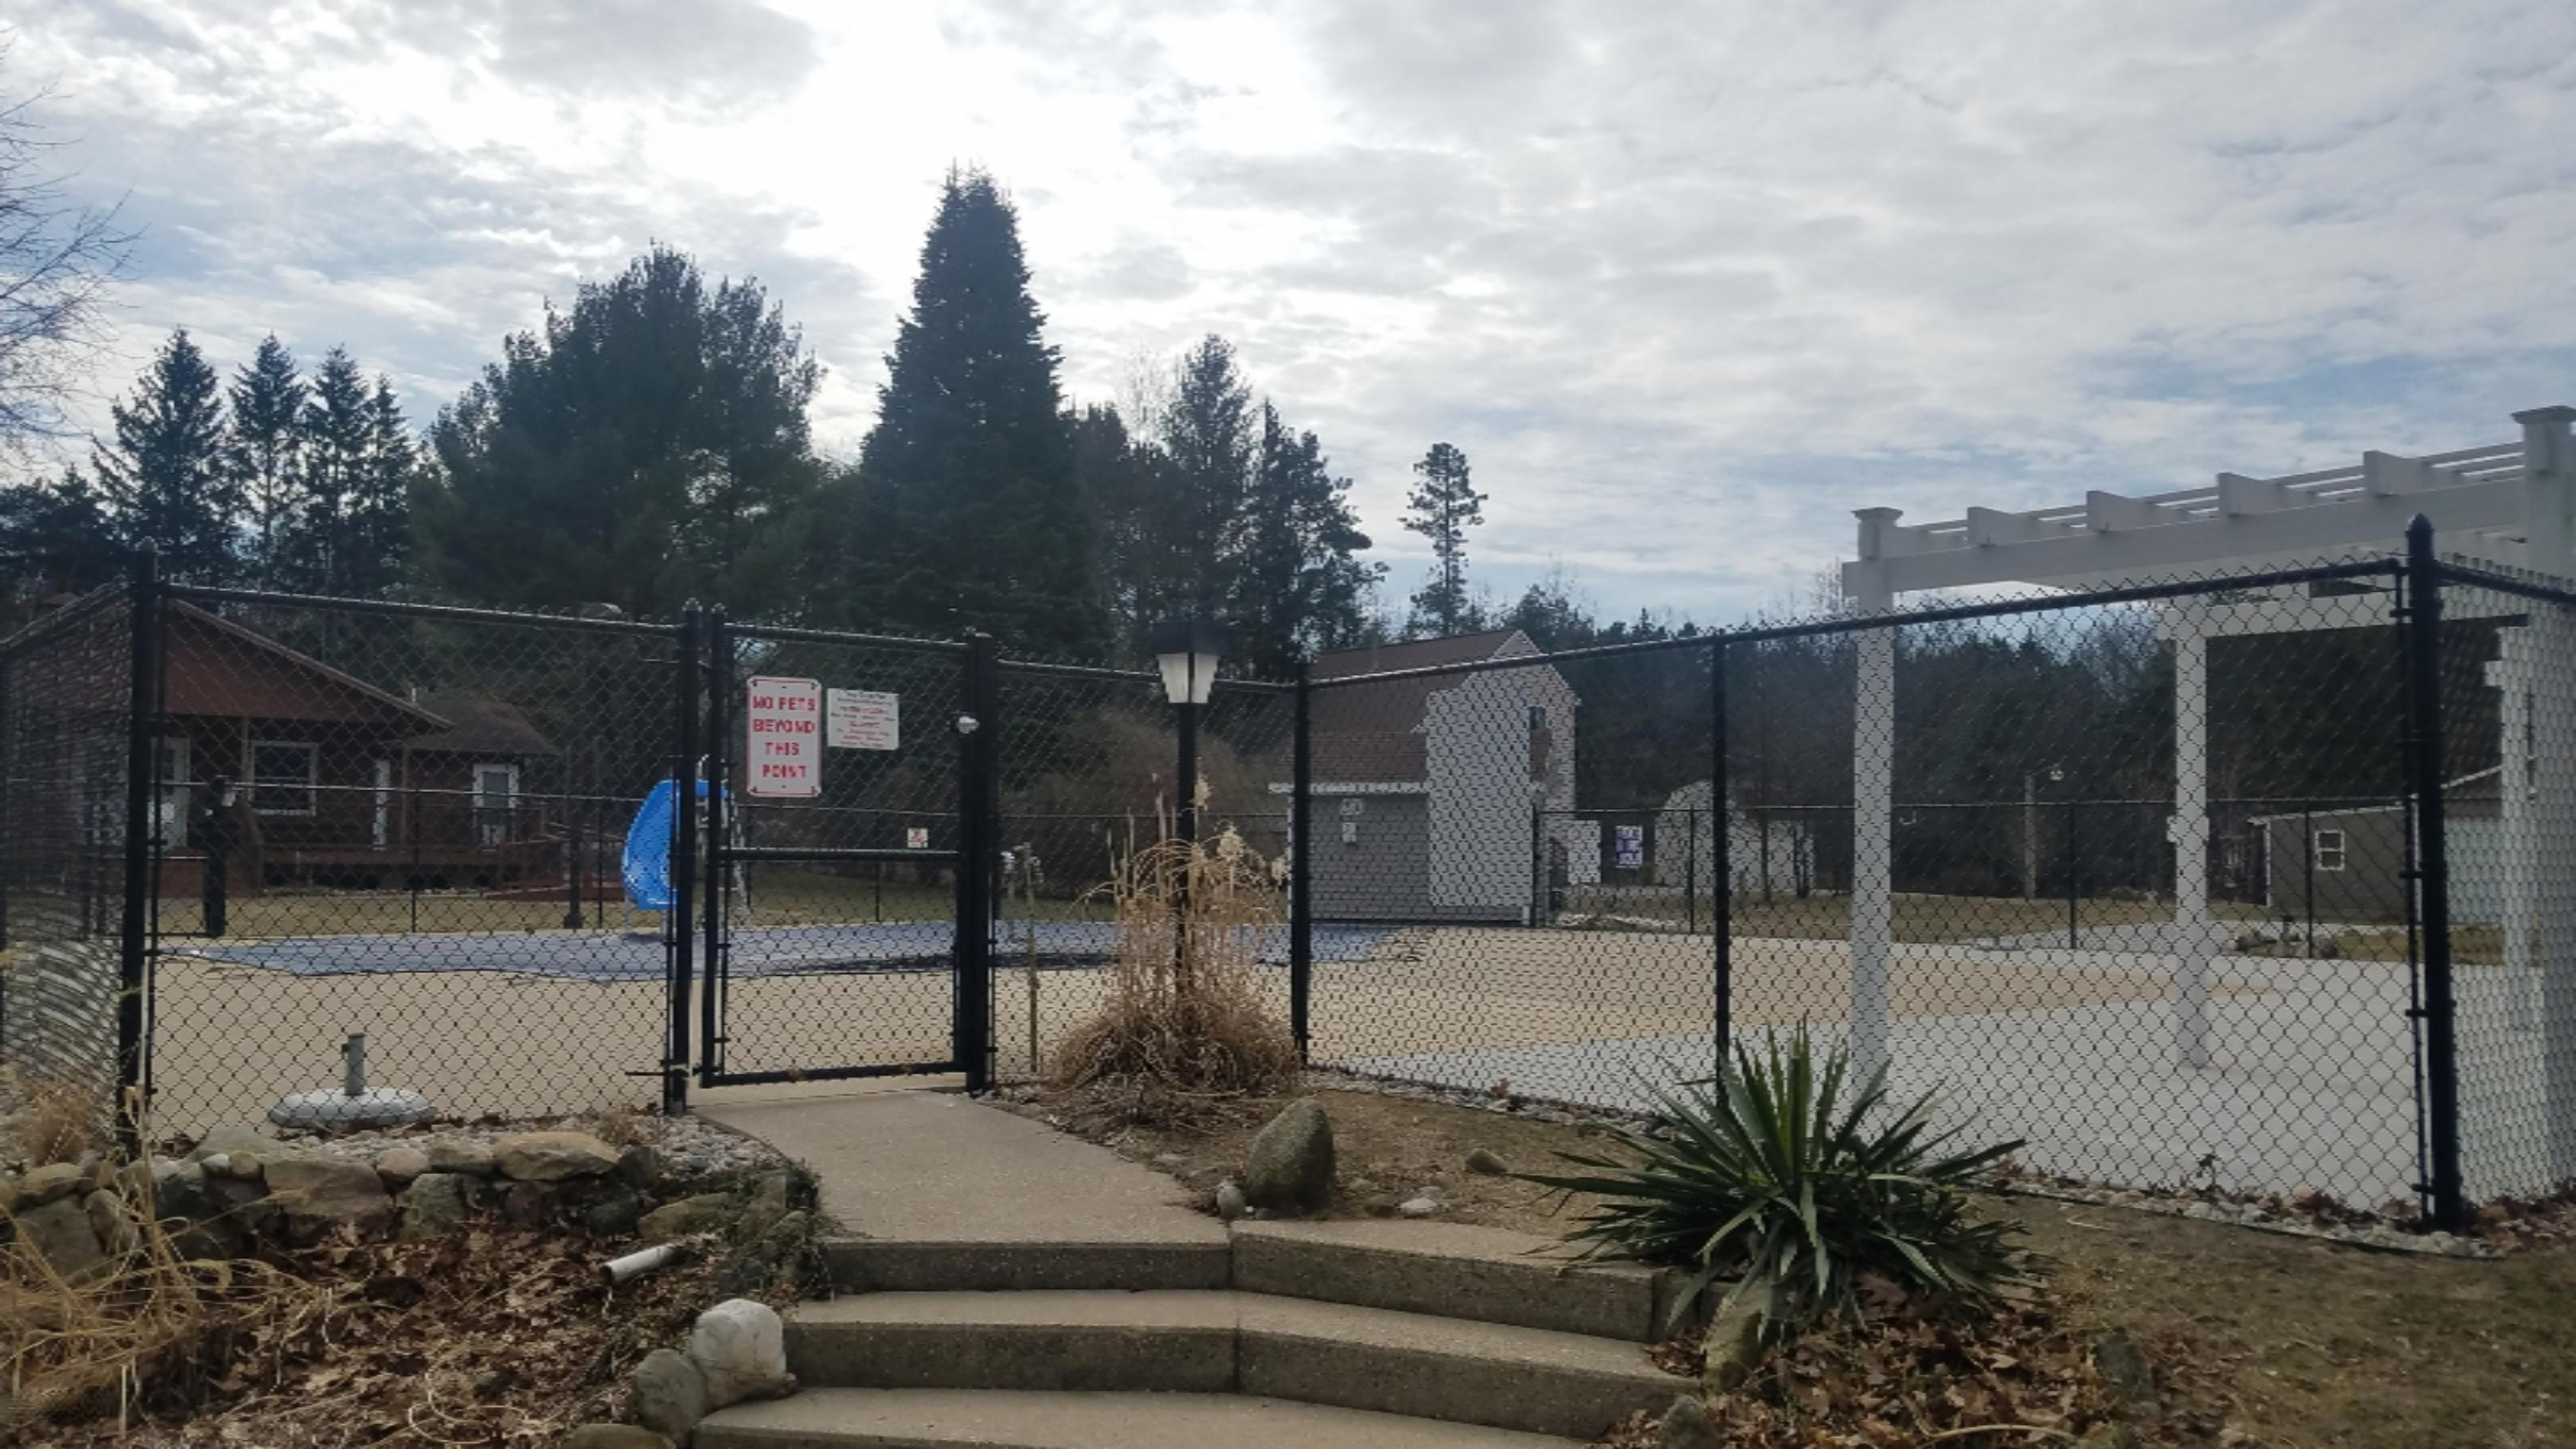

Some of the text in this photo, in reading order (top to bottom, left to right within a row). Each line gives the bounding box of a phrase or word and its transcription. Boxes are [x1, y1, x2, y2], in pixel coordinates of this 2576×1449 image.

[753, 696, 816, 711] NO PETS
[753, 719, 815, 734] BEYOND
[765, 742, 799, 756] THIS
[762, 764, 807, 778] POINT
